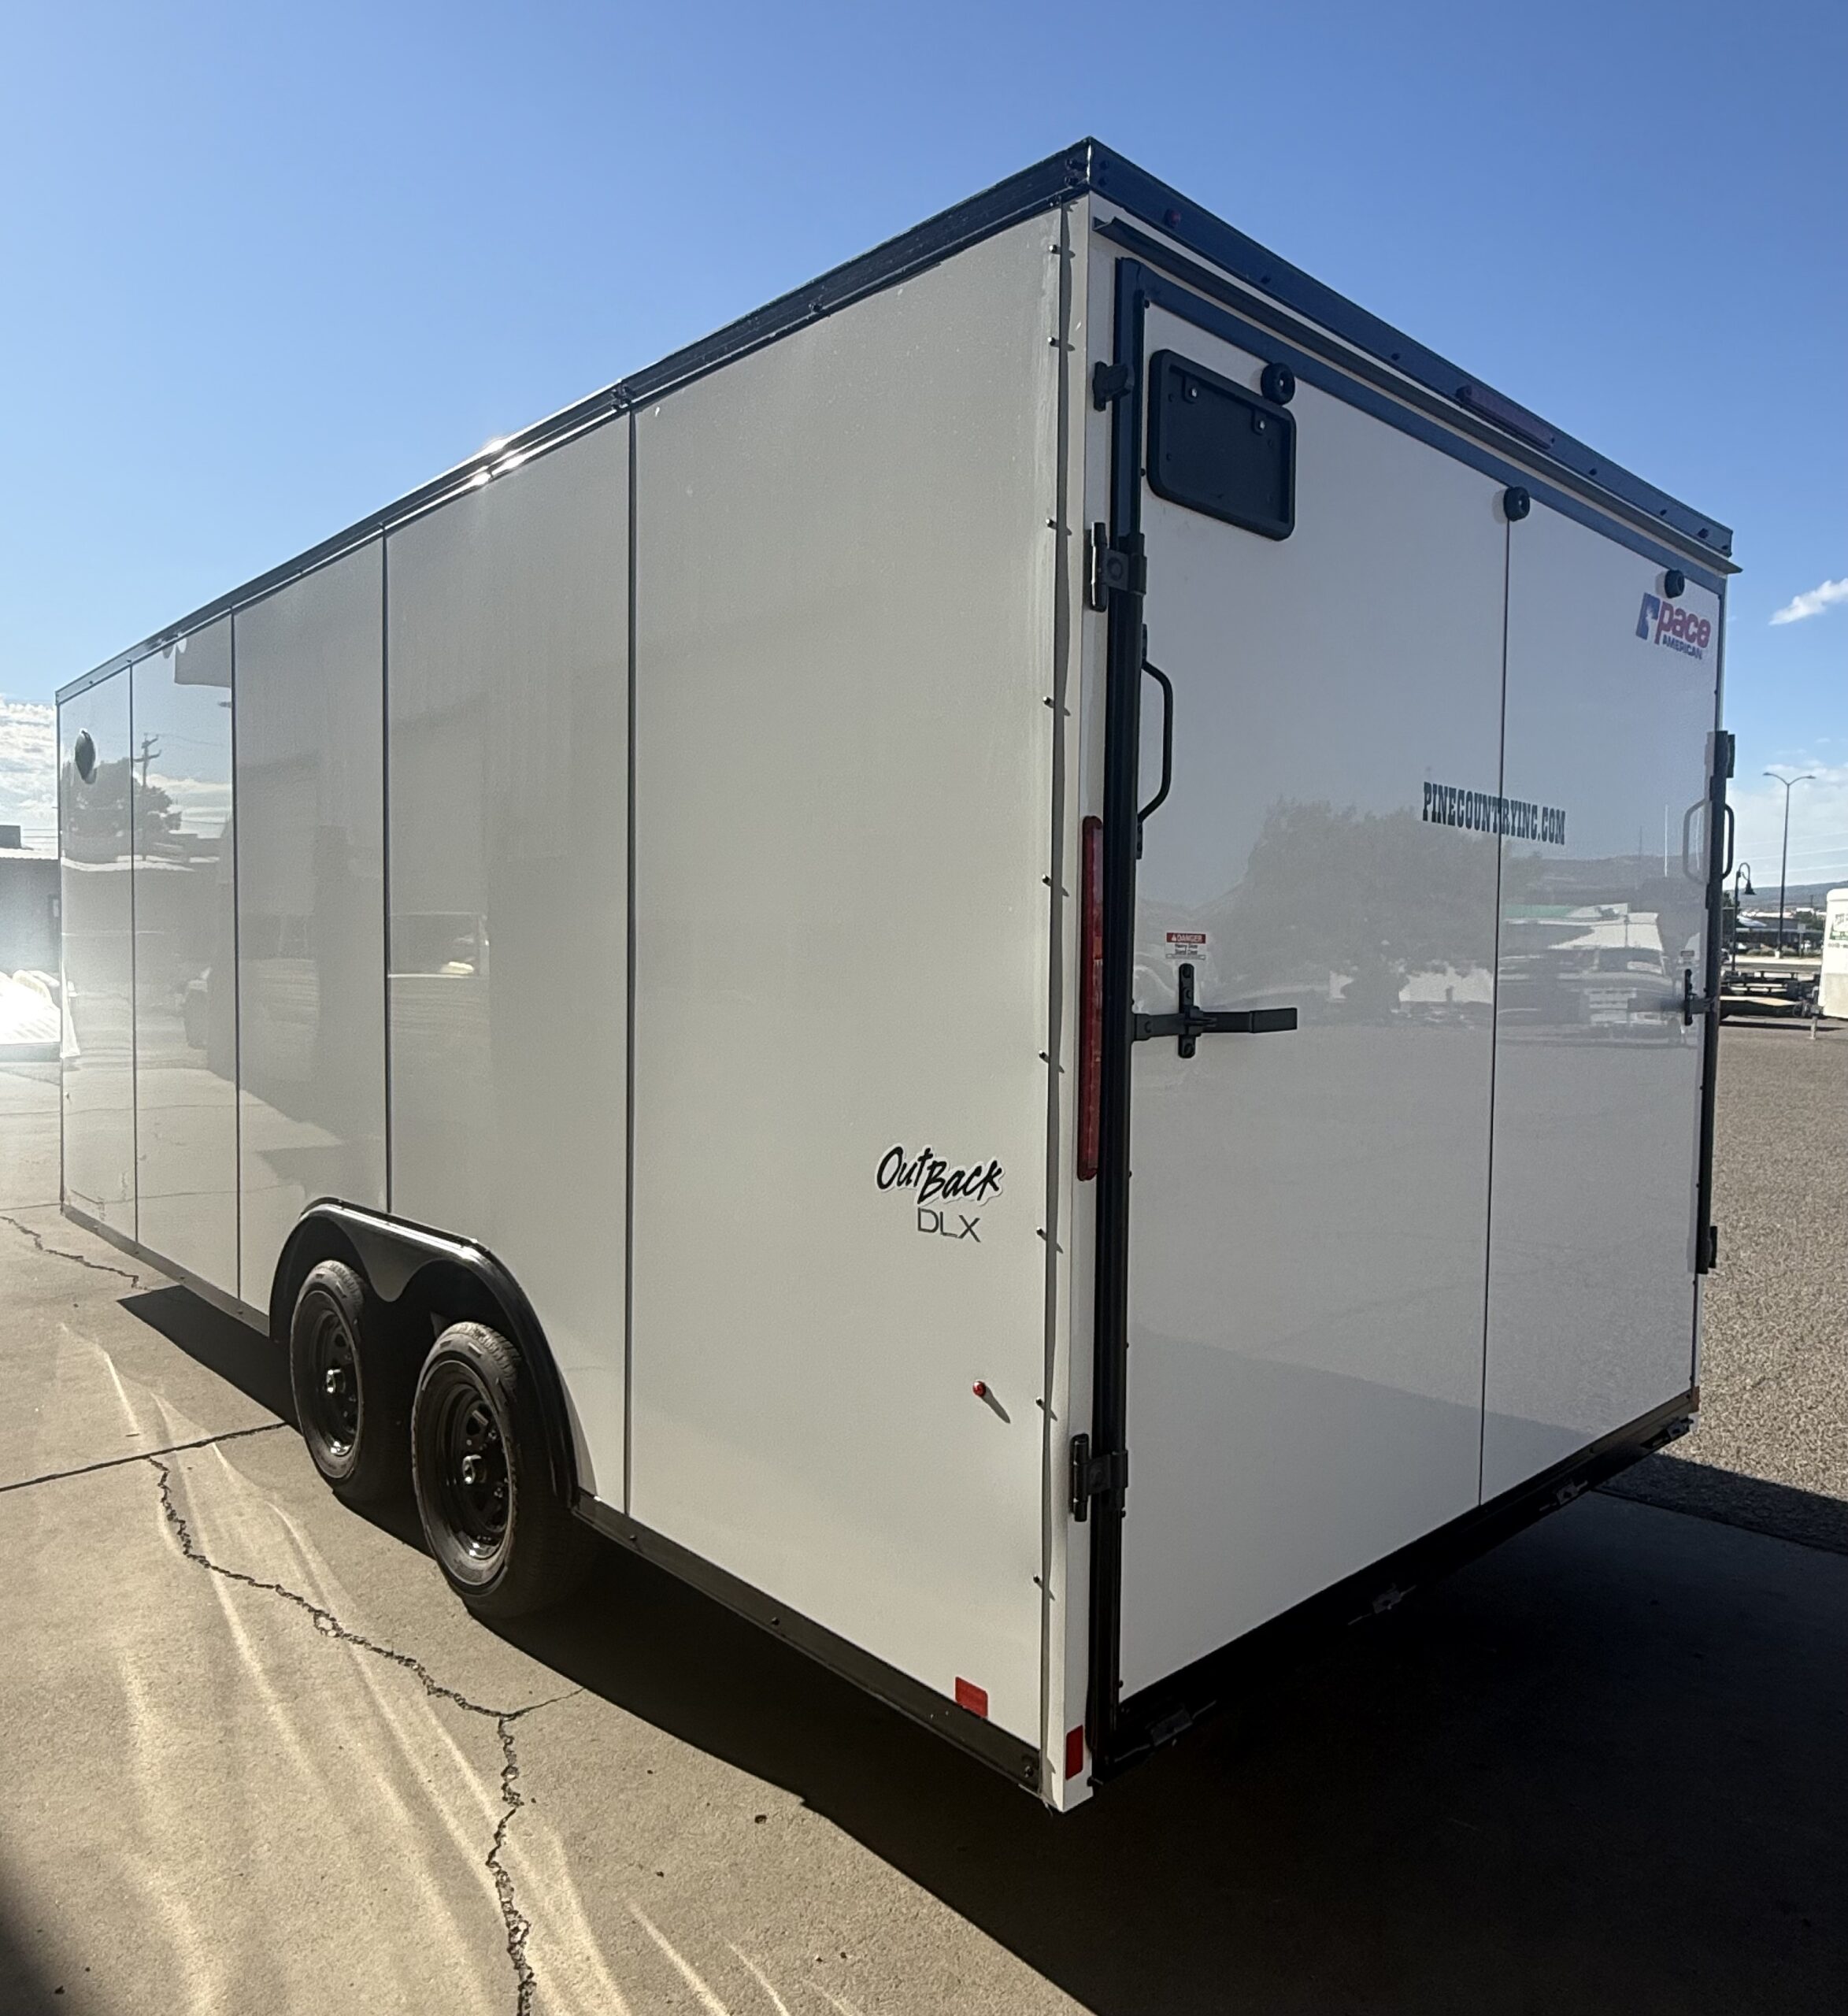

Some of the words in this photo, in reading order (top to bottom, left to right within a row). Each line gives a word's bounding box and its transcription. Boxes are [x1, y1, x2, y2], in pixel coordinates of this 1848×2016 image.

[1654, 601, 1711, 649] pace
[1662, 634, 1702, 660] AMERICAN
[1423, 781, 1566, 845] PINECOUNTRYINC.COM
[917, 1207, 981, 1243] DLX
